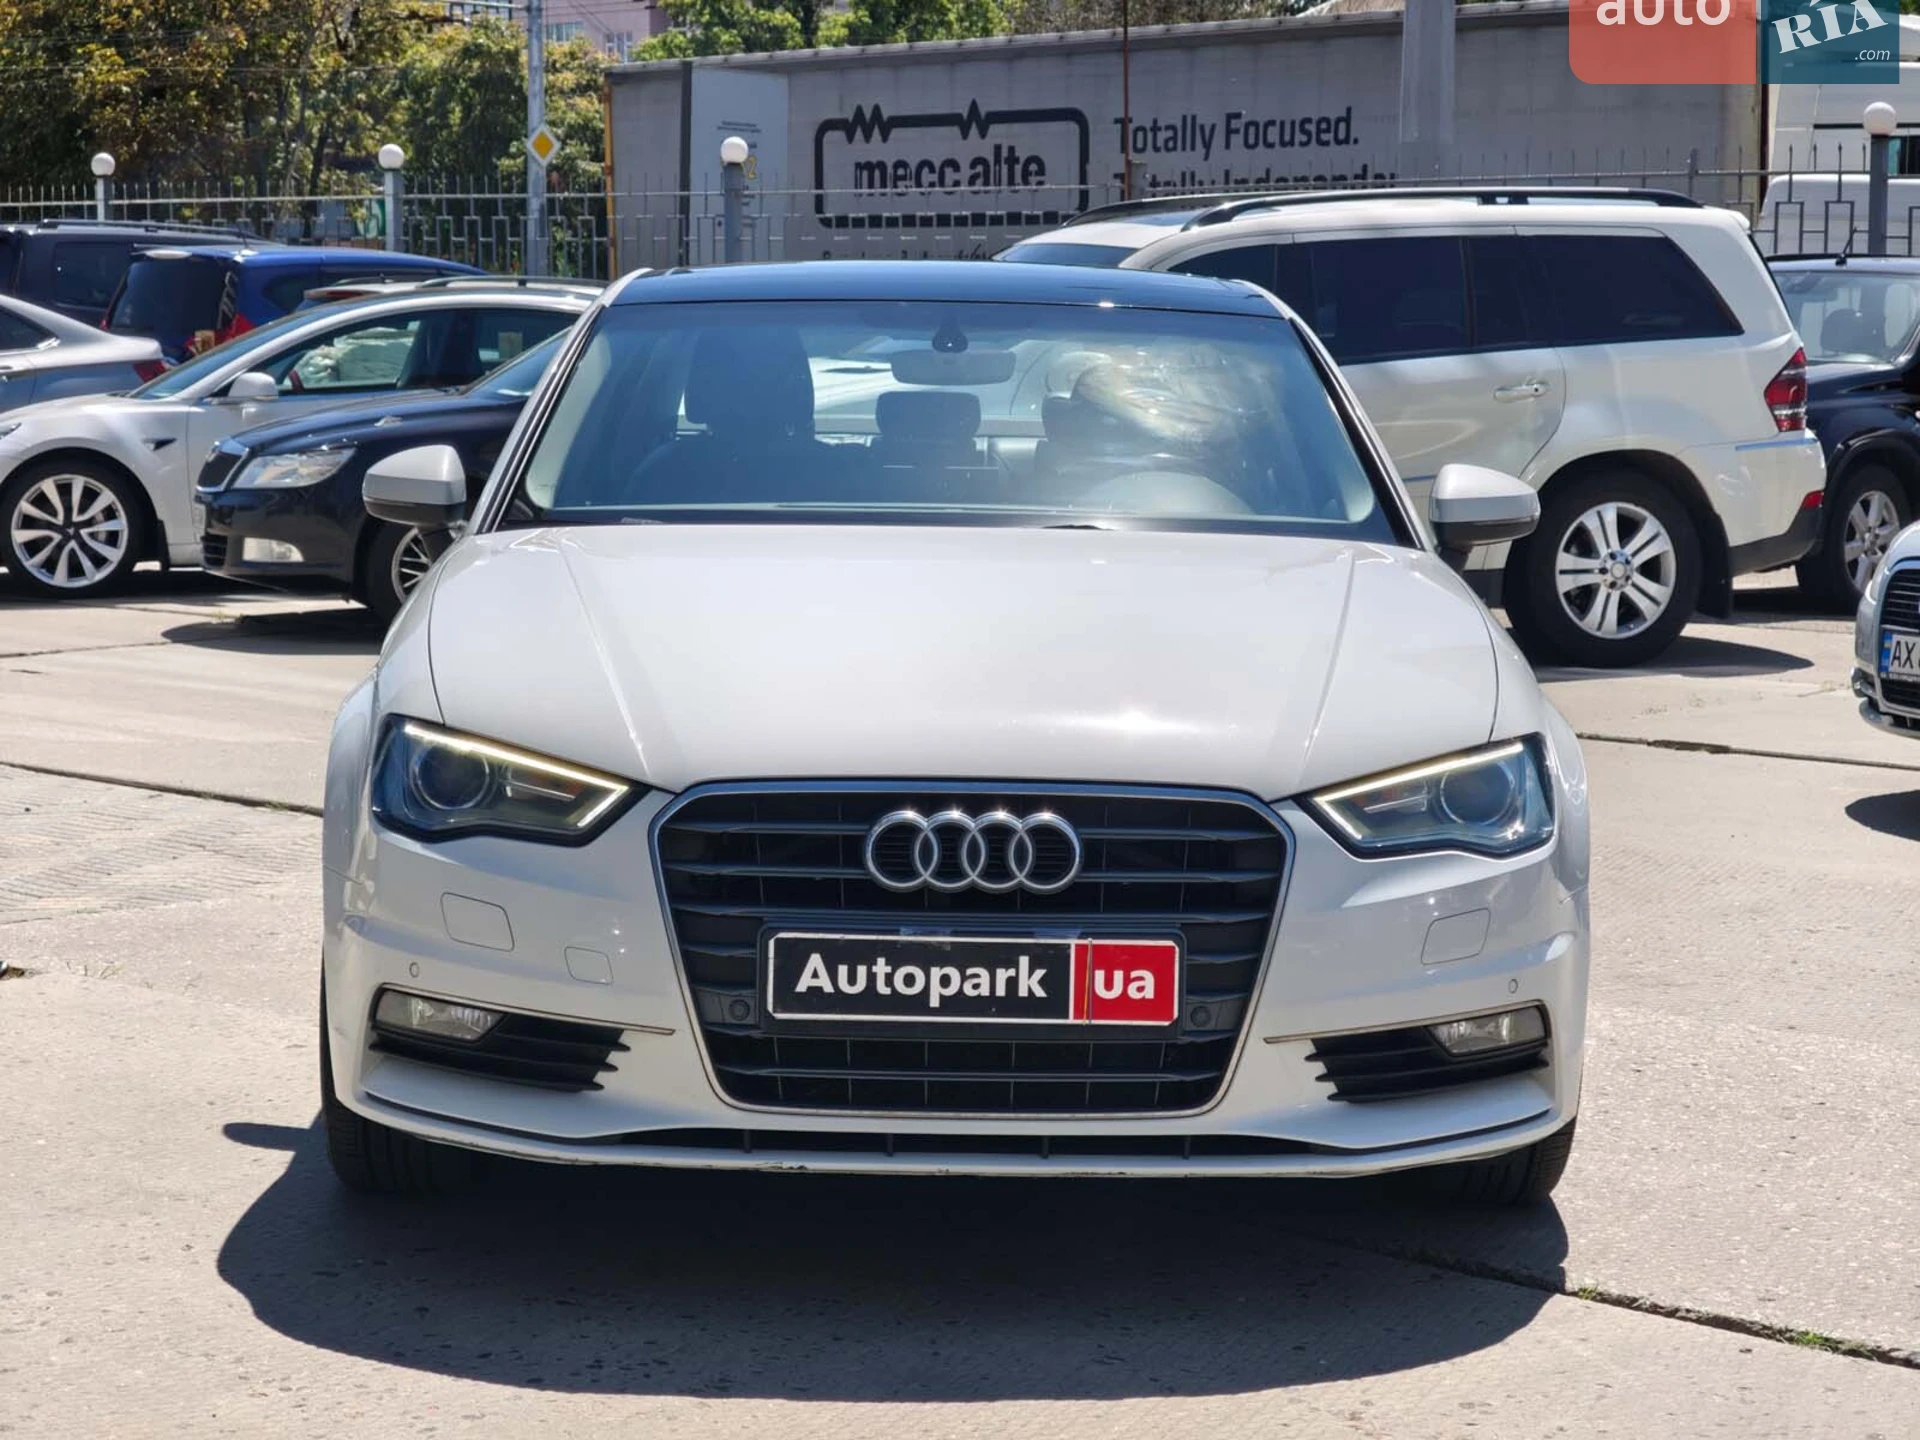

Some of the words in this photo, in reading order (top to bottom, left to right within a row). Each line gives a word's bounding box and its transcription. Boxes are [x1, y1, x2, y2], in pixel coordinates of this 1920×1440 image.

[1113, 113, 1216, 161] Totally
[1224, 106, 1359, 150] Focused.
[794, 952, 1048, 1008] Autopark
[1094, 969, 1156, 999] ua
